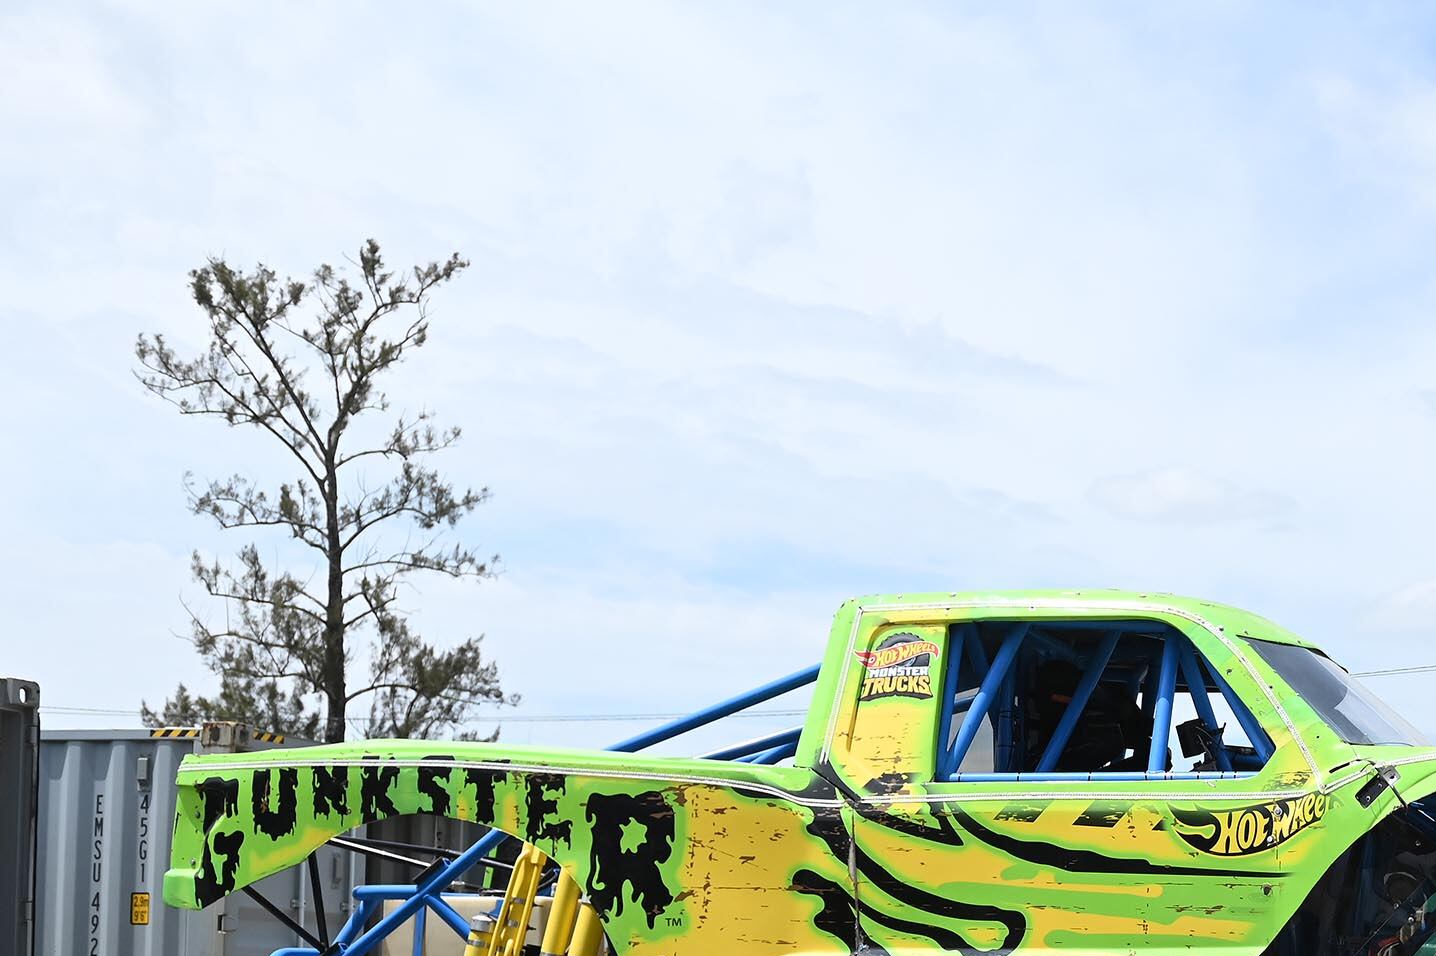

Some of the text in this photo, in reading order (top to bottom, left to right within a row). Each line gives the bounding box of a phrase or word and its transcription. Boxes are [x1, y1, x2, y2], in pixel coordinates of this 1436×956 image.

[874, 642, 936, 668] HOT WHEELS
[869, 666, 929, 678] MONSTER
[860, 676, 935, 699] TRUCKS
[92, 794, 104, 882] EMSU
[138, 794, 149, 882] 45G1
[1209, 809, 1270, 853] HOT
[665, 917, 682, 927] TM
